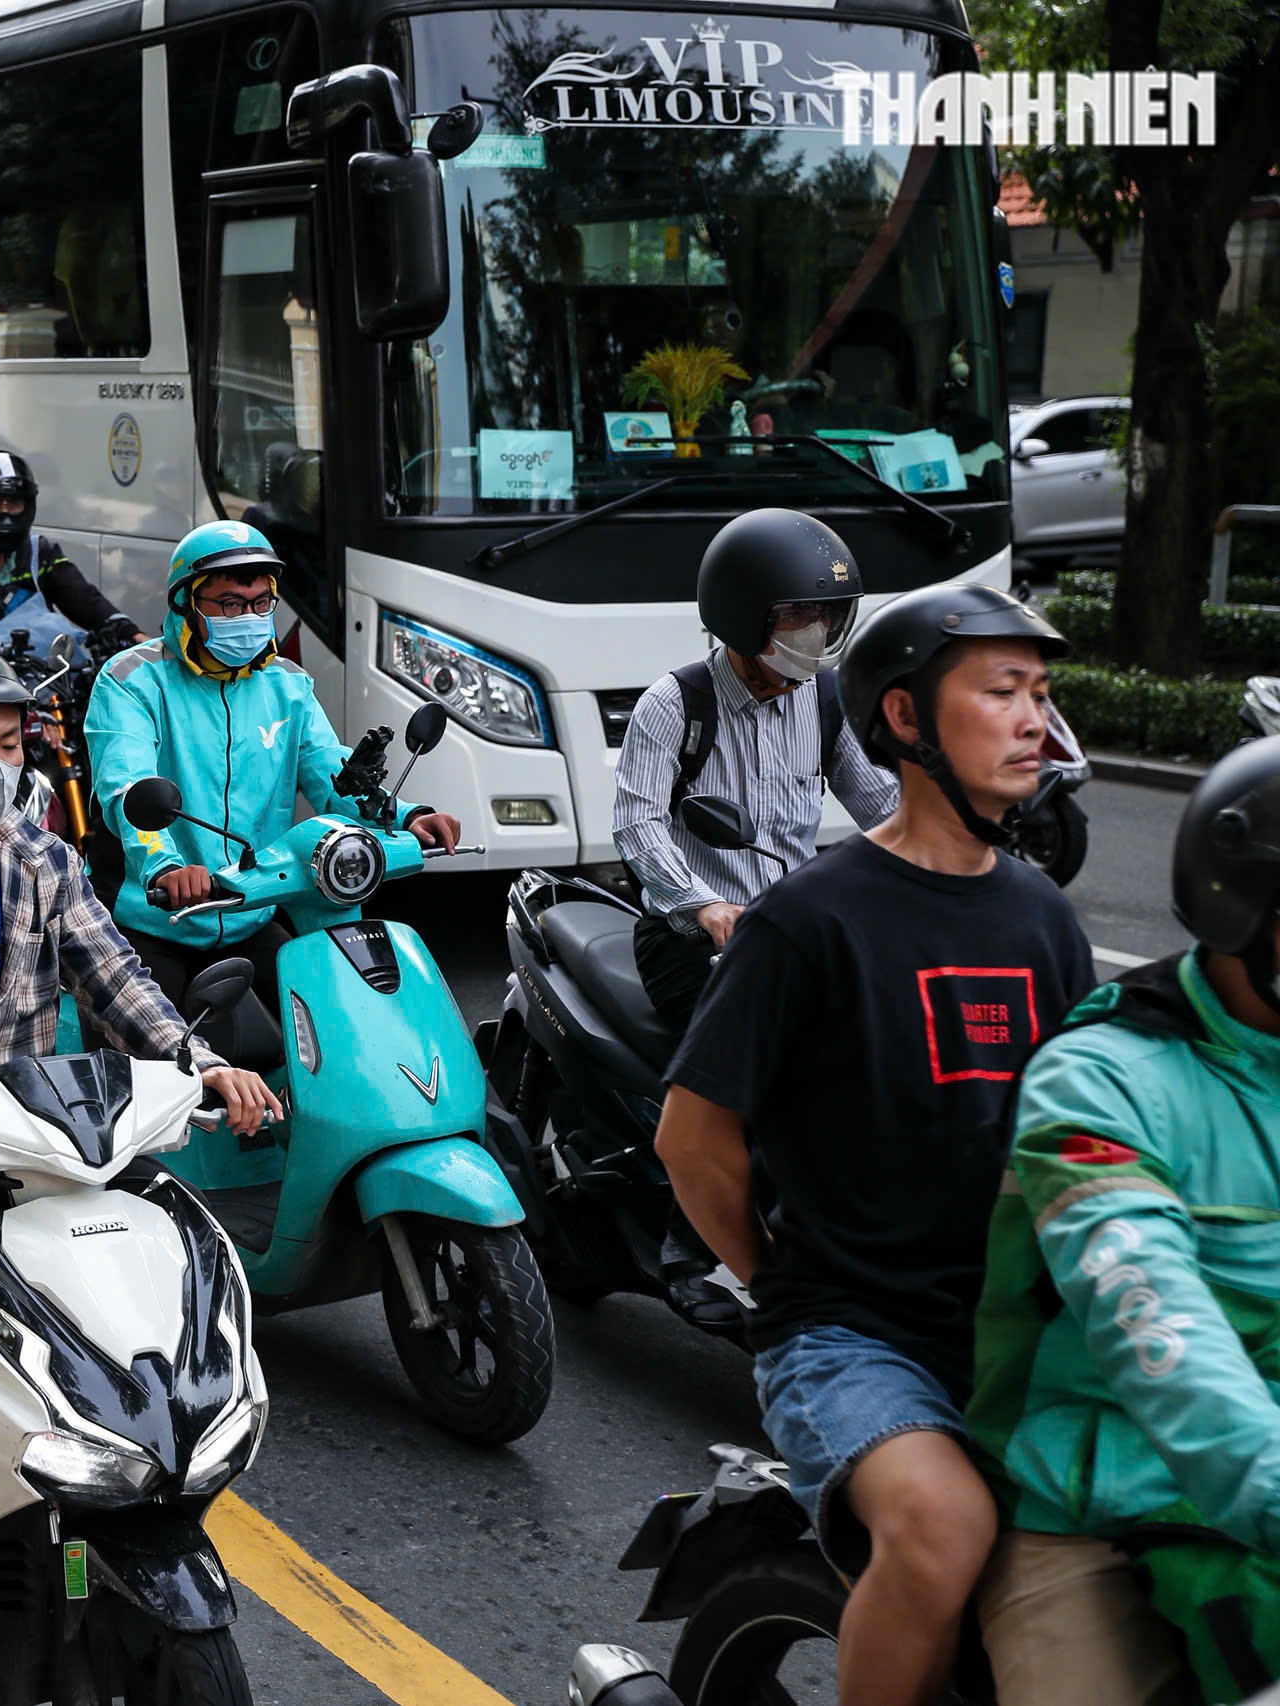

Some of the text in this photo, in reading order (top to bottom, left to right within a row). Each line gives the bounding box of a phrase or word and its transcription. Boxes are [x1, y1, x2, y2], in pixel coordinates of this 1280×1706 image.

[640, 37, 783, 88] VIP
[71, 1221, 128, 1237] HONDA
[1080, 1217, 1195, 1378] Grab
